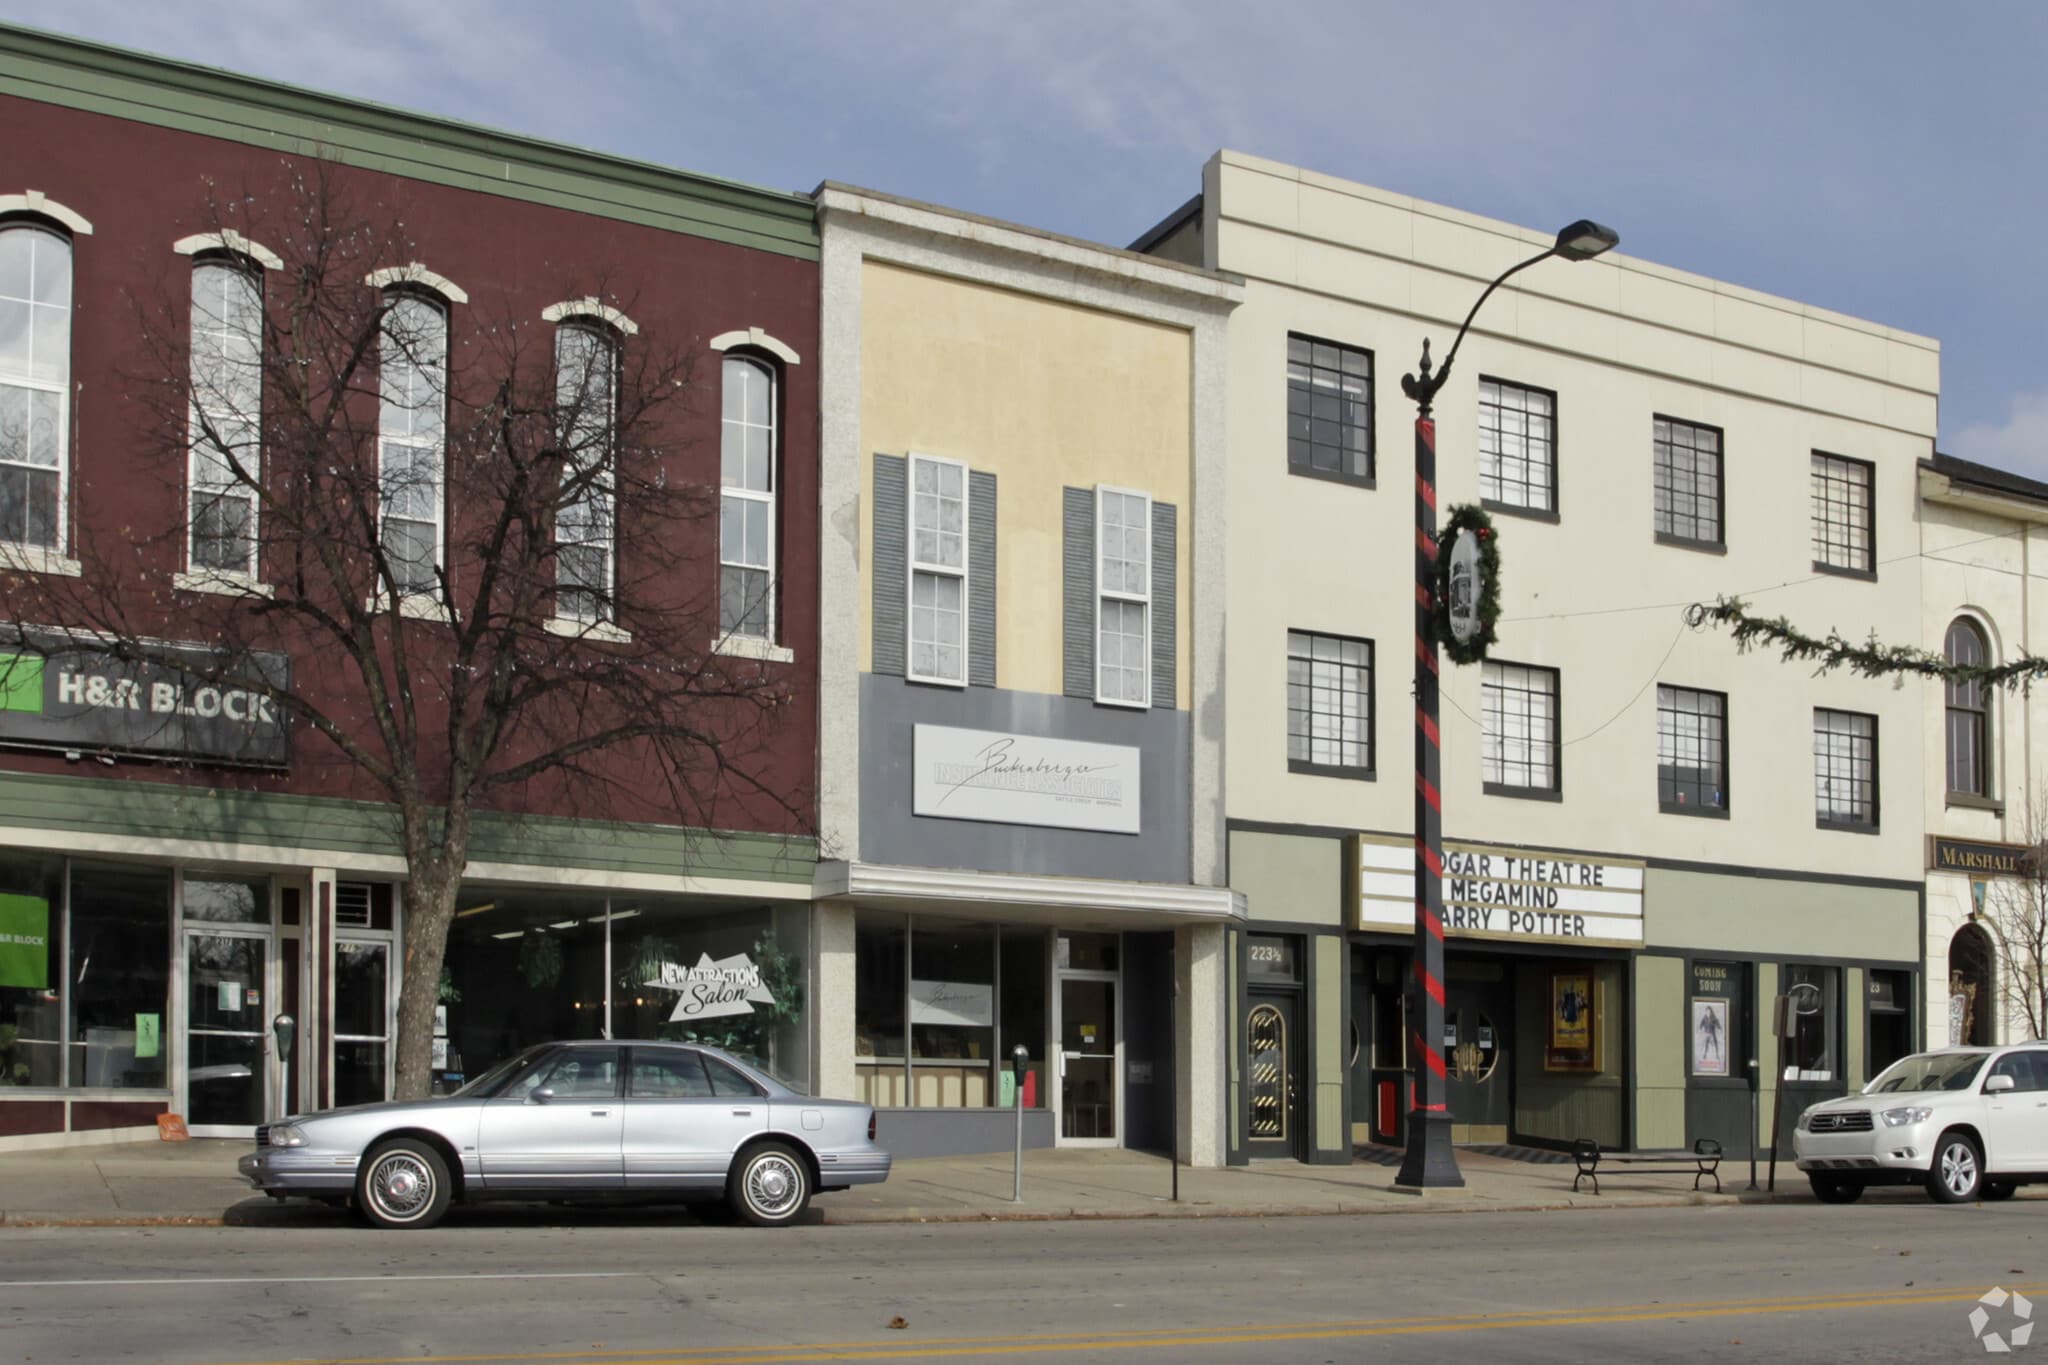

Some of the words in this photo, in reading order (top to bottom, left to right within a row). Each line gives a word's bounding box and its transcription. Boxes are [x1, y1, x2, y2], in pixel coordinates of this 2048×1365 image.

[57, 670, 142, 711] H&R
[150, 681, 275, 724] BLOCK
[1440, 851, 1492, 878] OGAR
[1504, 856, 1604, 887] THEATRE
[1941, 846, 2017, 871] MARSHALL
[1450, 878, 1559, 909] MEGAMIND
[1440, 904, 1492, 929] ARRY
[1509, 909, 1586, 937] POTTER
[14, 935, 44, 946] BLOCK
[661, 961, 688, 985] NEW
[687, 964, 761, 988] ATTRACTIONS
[1694, 966, 1727, 978] COMING
[1699, 980, 1722, 993] SOON
[683, 981, 750, 1015] Salon
